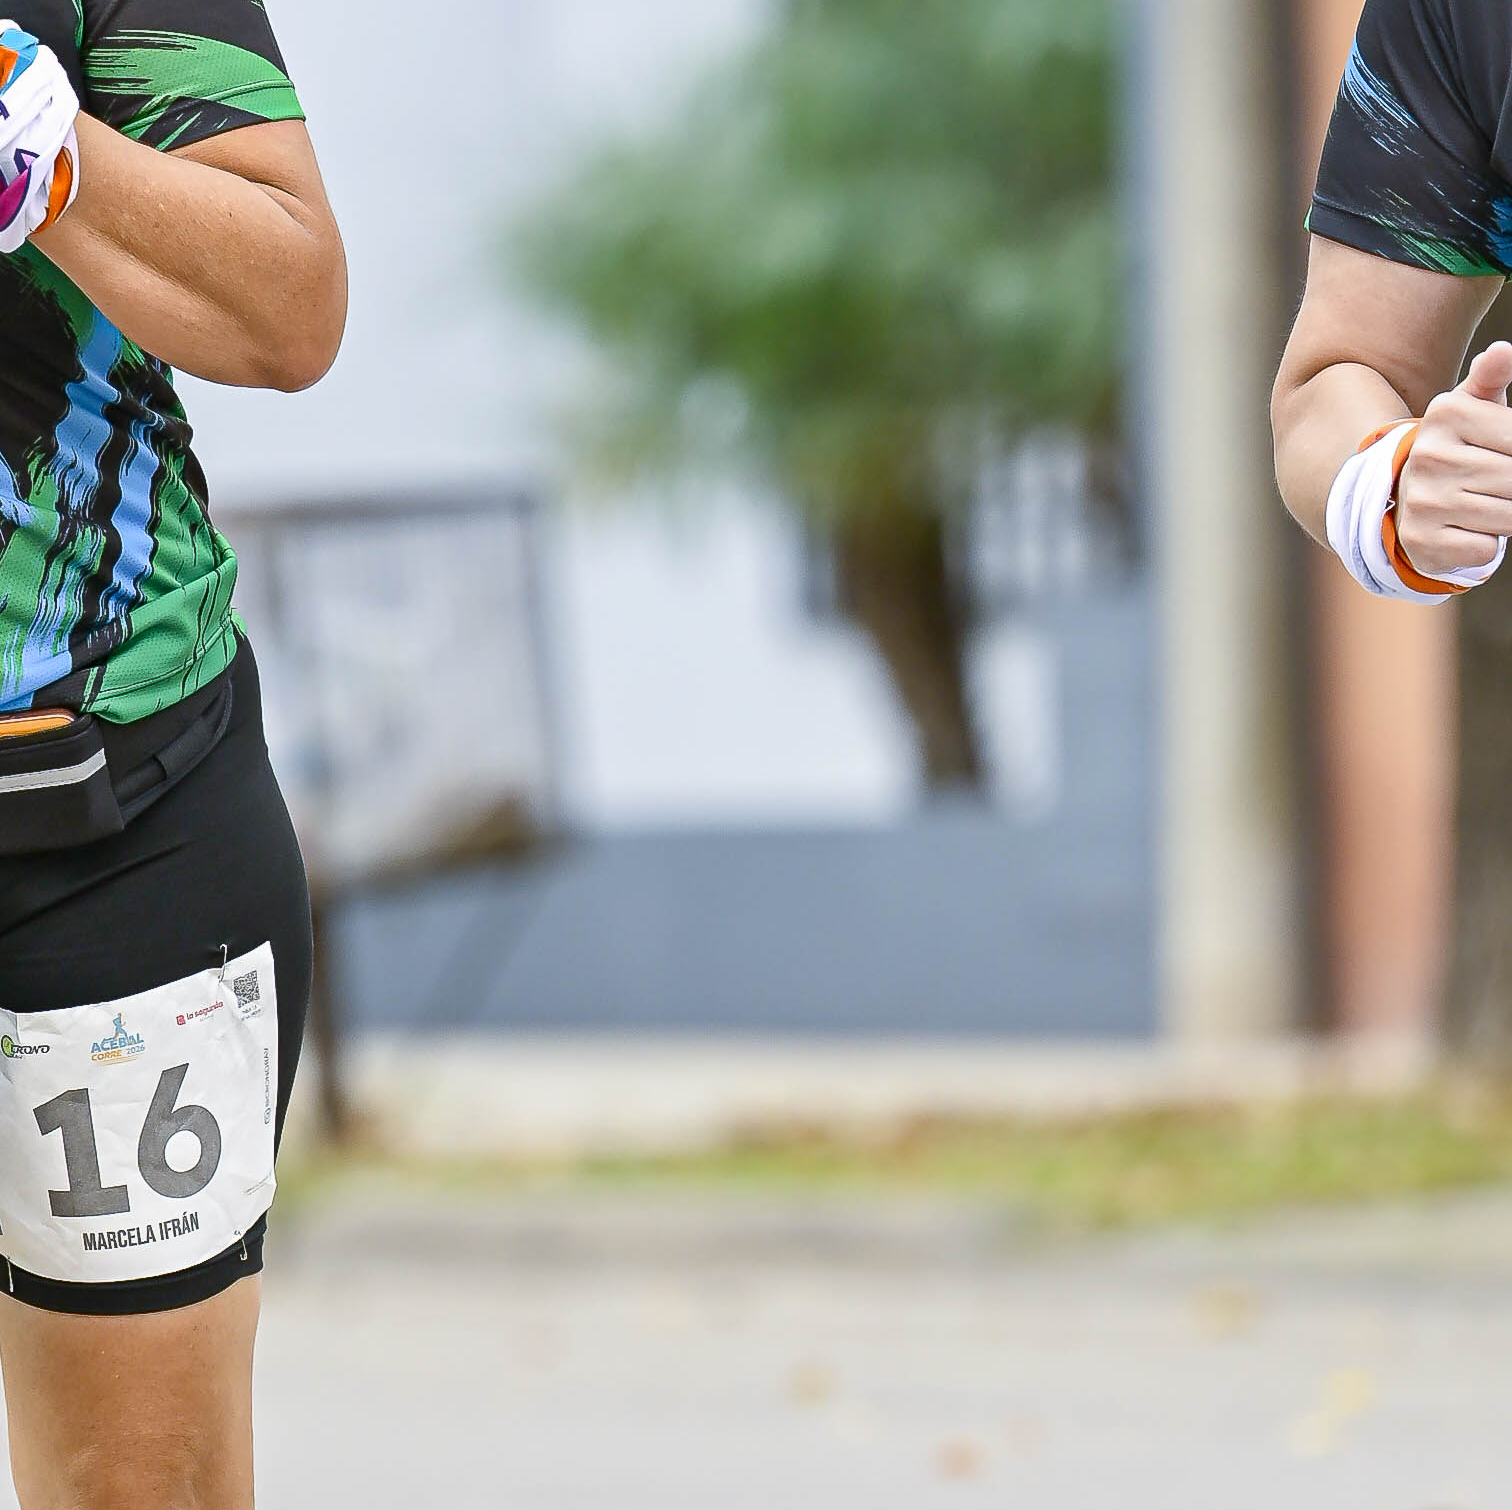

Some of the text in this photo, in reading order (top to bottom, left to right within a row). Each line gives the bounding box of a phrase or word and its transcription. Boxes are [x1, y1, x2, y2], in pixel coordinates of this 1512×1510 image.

[91, 1050, 122, 1061] CORRE
[33, 1062, 222, 1217] 16
[82, 1211, 200, 1251] MARCELA IFRÁN
